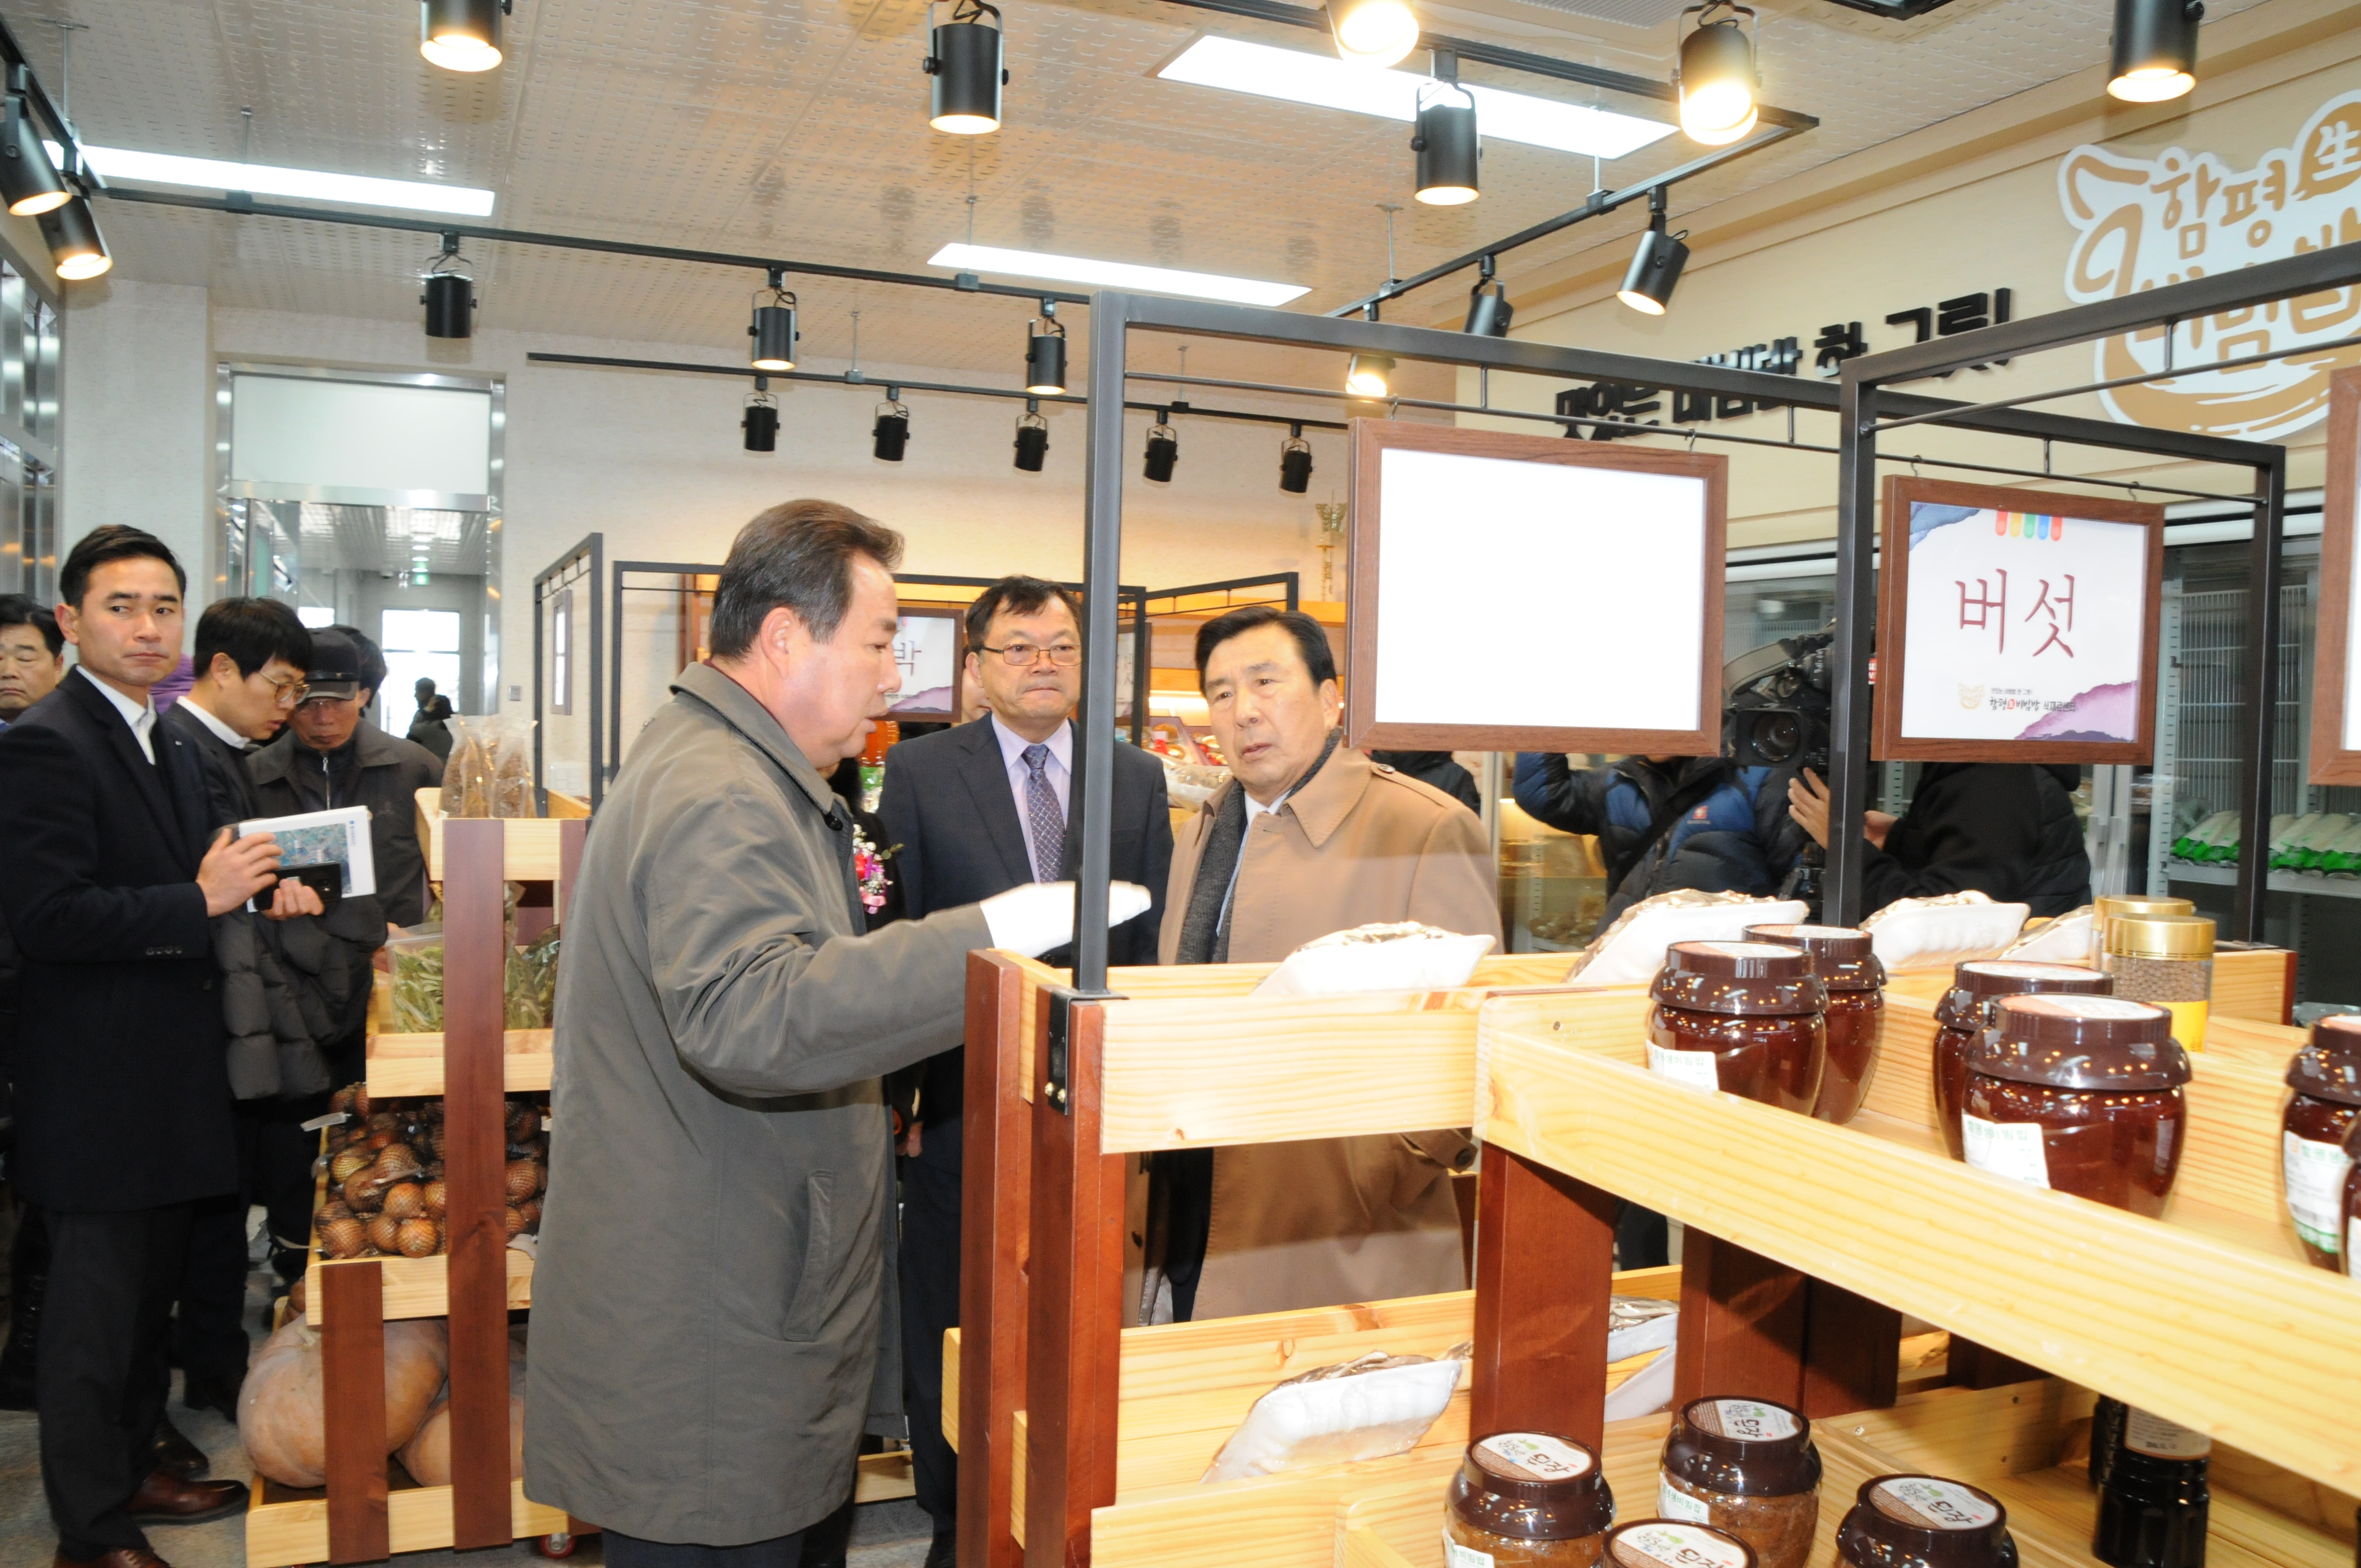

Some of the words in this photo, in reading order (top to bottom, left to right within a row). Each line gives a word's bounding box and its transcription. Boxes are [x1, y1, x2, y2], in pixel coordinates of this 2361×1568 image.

[2150, 156, 2287, 260] 함평
[1954, 568, 2075, 658] 버섯
[1527, 1453, 1570, 1473] 된장
[1928, 1500, 1973, 1524] 된장
